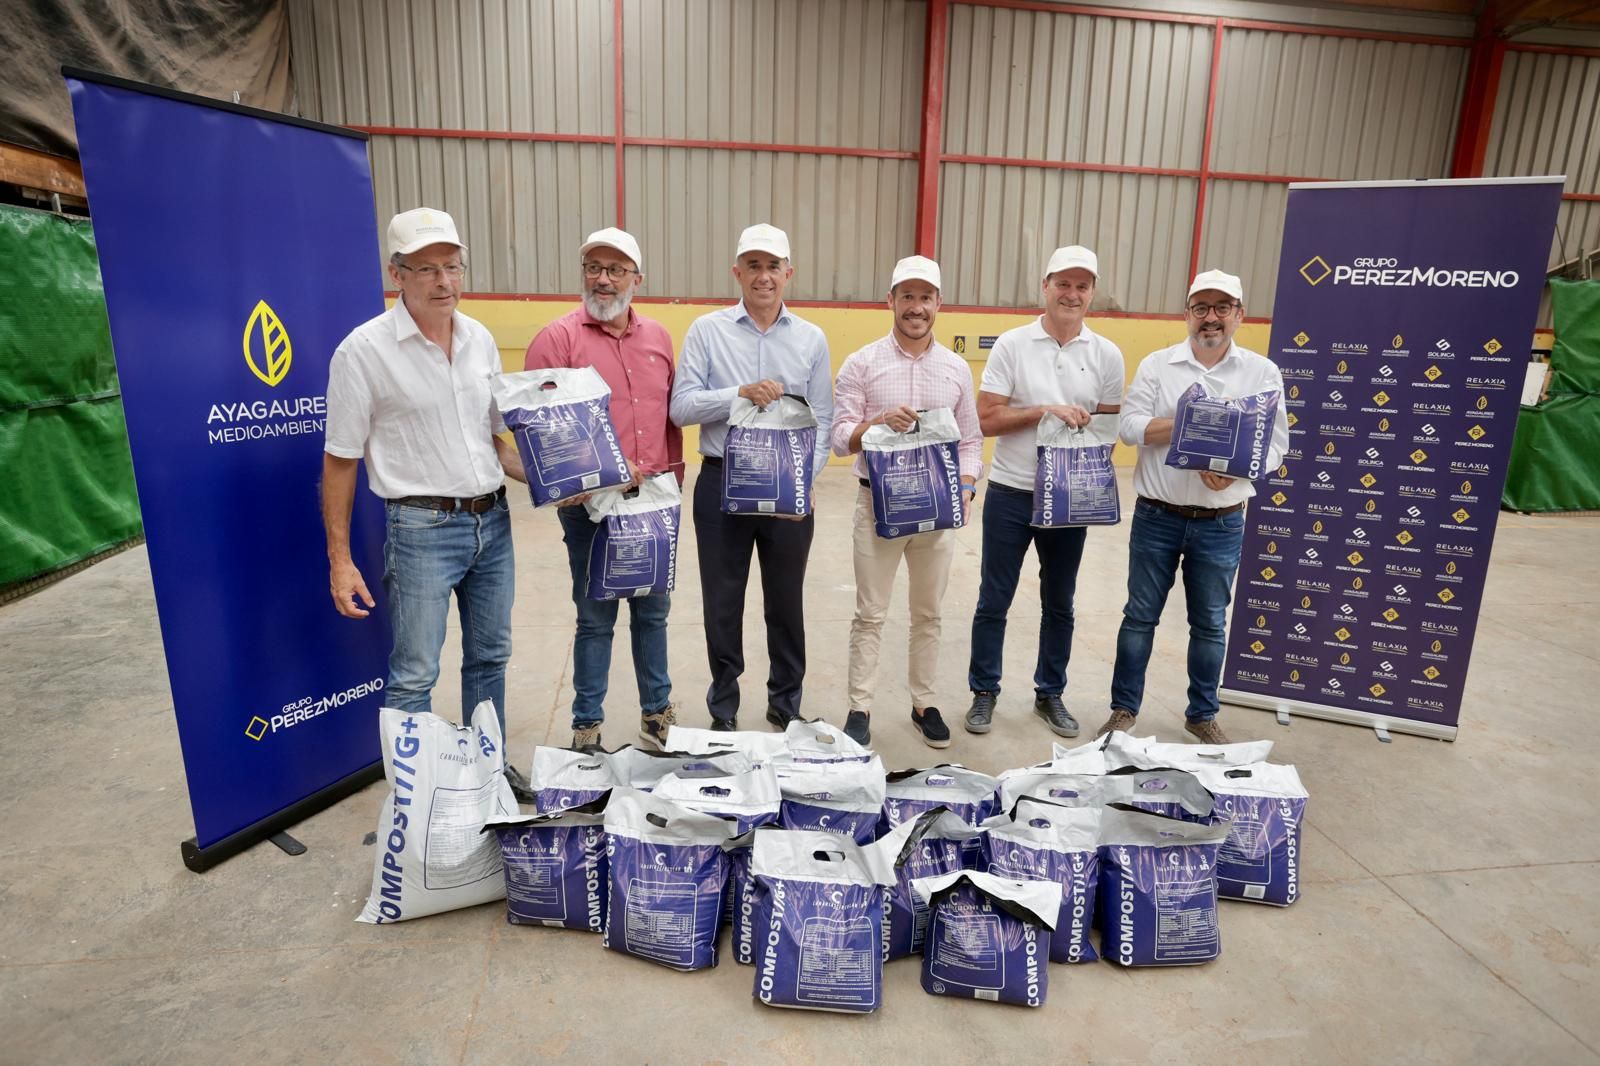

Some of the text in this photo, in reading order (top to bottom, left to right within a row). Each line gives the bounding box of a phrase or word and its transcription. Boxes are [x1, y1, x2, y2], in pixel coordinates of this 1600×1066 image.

[1354, 258, 1398, 268] GRUPO
[1334, 265, 1519, 288] PEREZMORENO
[207, 396, 327, 424] AYAGAURE
[1451, 462, 1489, 470] RELAXIA
[942, 444, 962, 528] COMPOST//G+
[1436, 544, 1473, 552] RELAXIA
[1386, 564, 1422, 572] RELAXIA
[1297, 580, 1330, 588] RELAXIA
[1422, 622, 1458, 630] RELAXIA
[1373, 641, 1408, 650] RELAXIA
[1286, 654, 1318, 662] RELAXIA
[1238, 671, 1269, 679] RELAXIA
[271, 678, 384, 733] PEREZMORENO
[282, 696, 312, 713] GRUPO
[1408, 698, 1443, 707] RELAXIA
[1068, 854, 1085, 963] COMPOST//G+
[1119, 846, 1134, 966] COMPOST//G+
